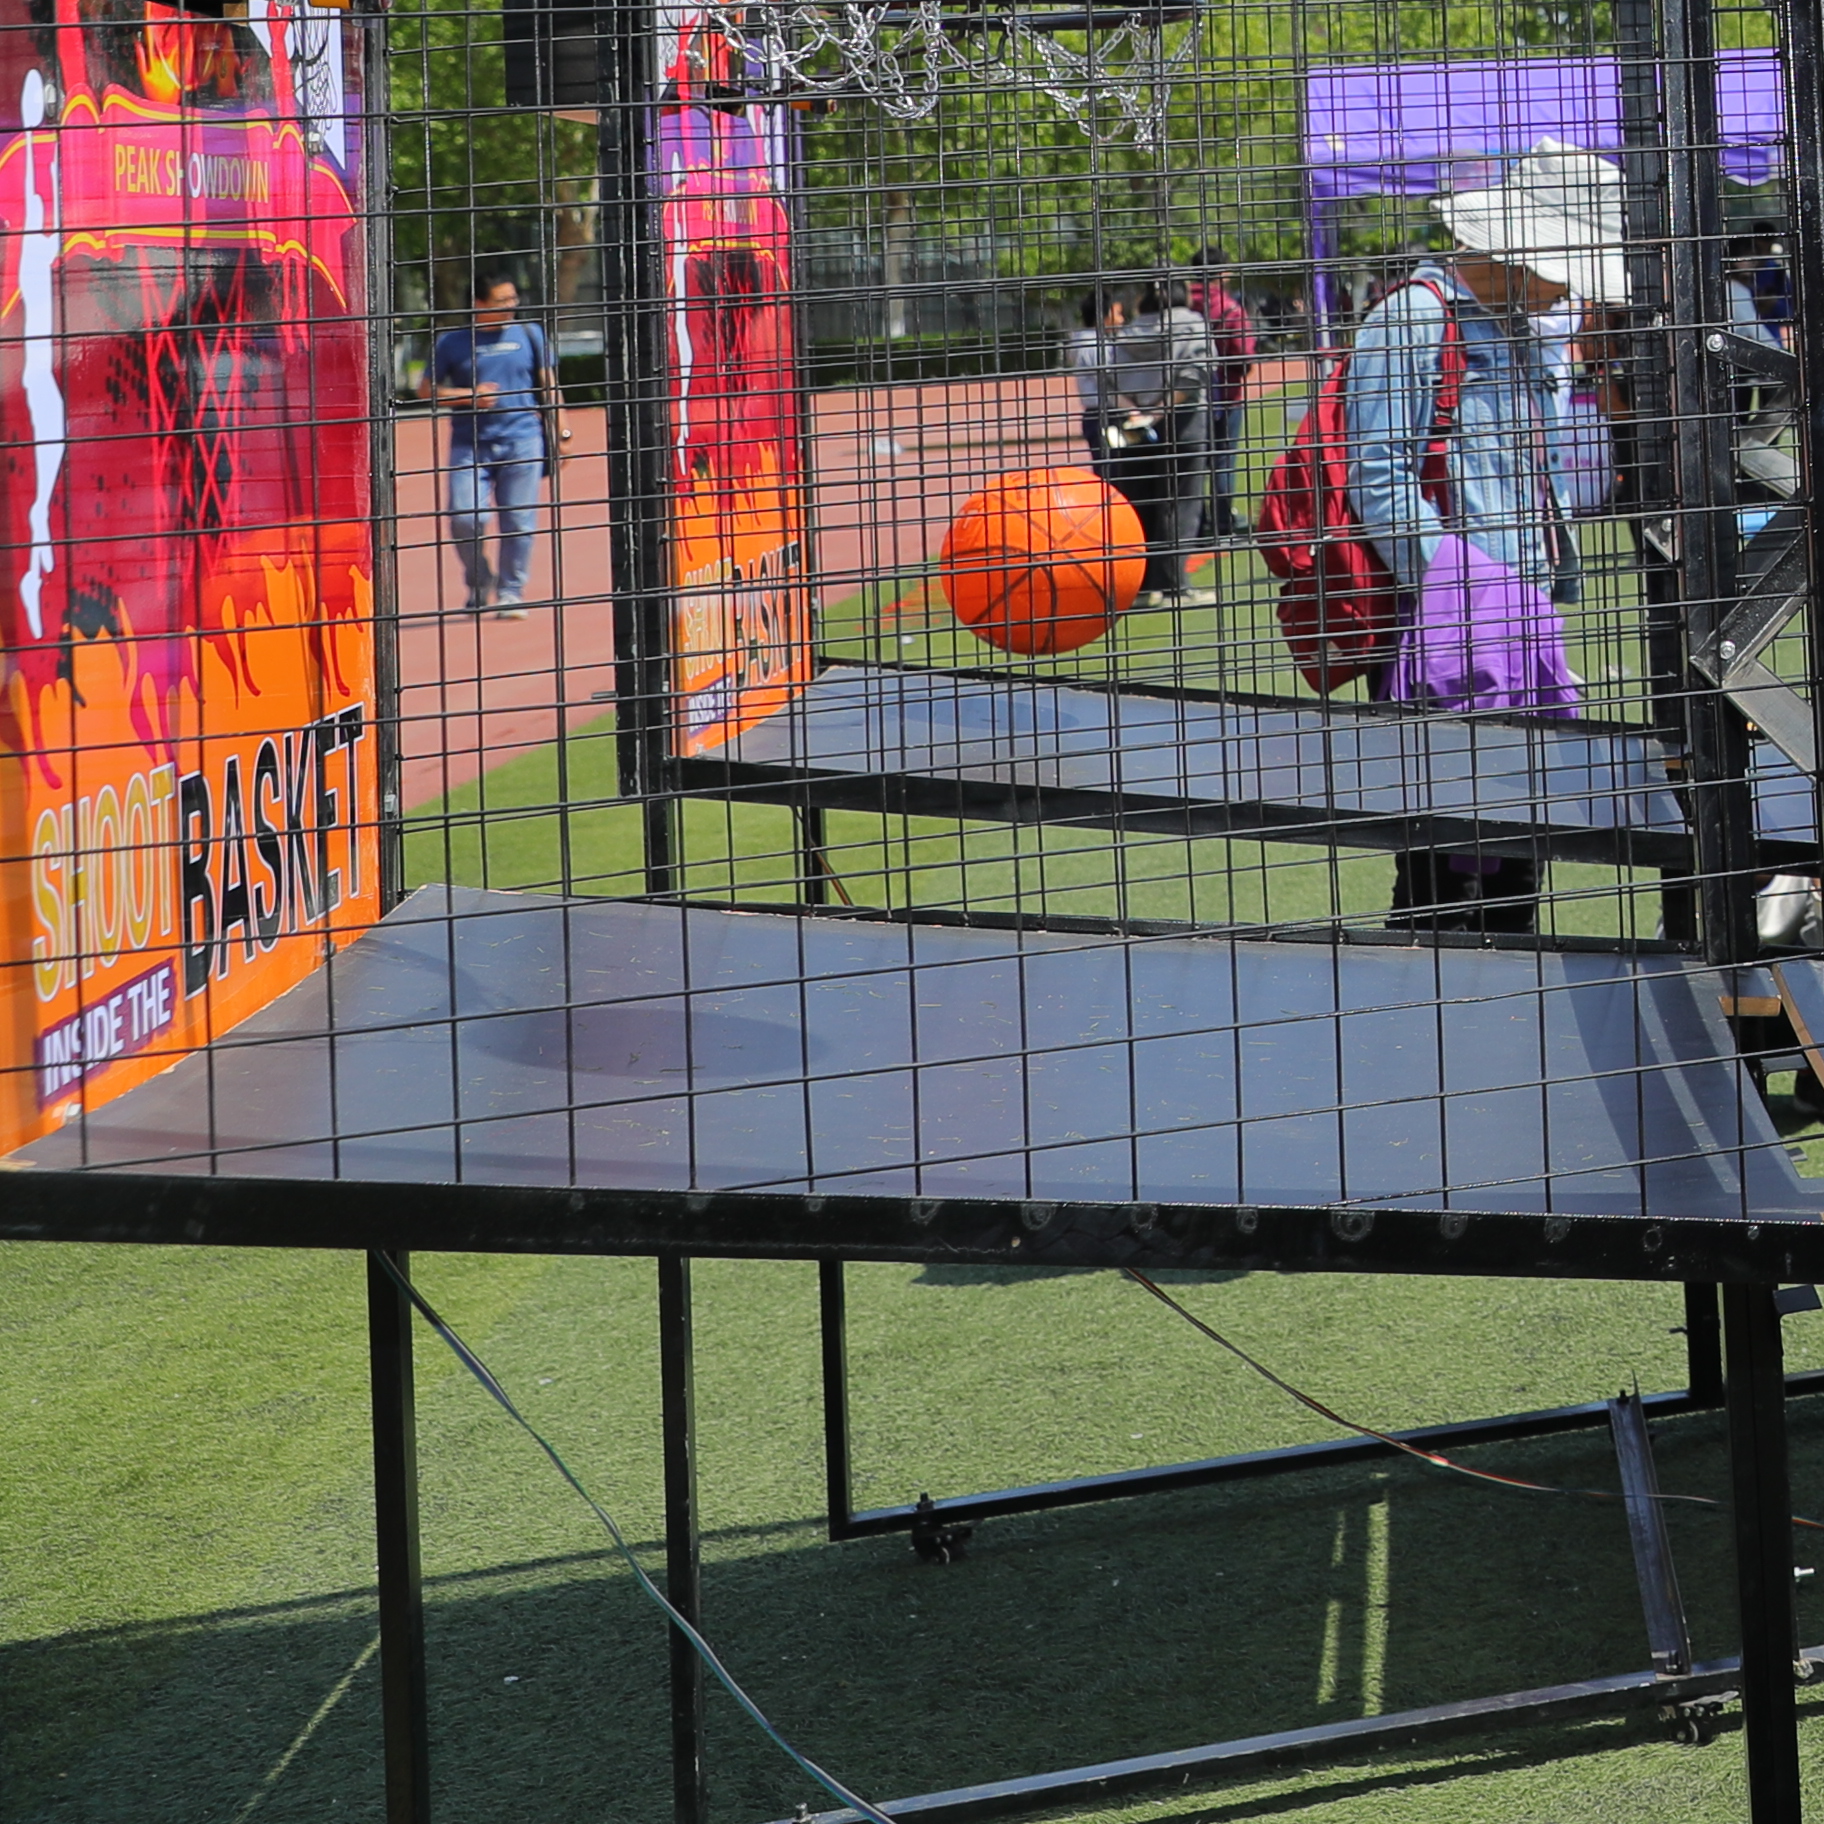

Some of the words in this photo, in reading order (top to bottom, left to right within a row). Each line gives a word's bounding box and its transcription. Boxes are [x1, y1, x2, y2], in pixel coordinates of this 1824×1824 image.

[115, 143, 161, 195] PEAK
[165, 149, 269, 203] SHOWDOWN
[33, 762, 176, 1002] SHOOT
[179, 701, 365, 1001] BASKET
[43, 1002, 125, 1098] INSIDE
[127, 966, 172, 1042] THE
